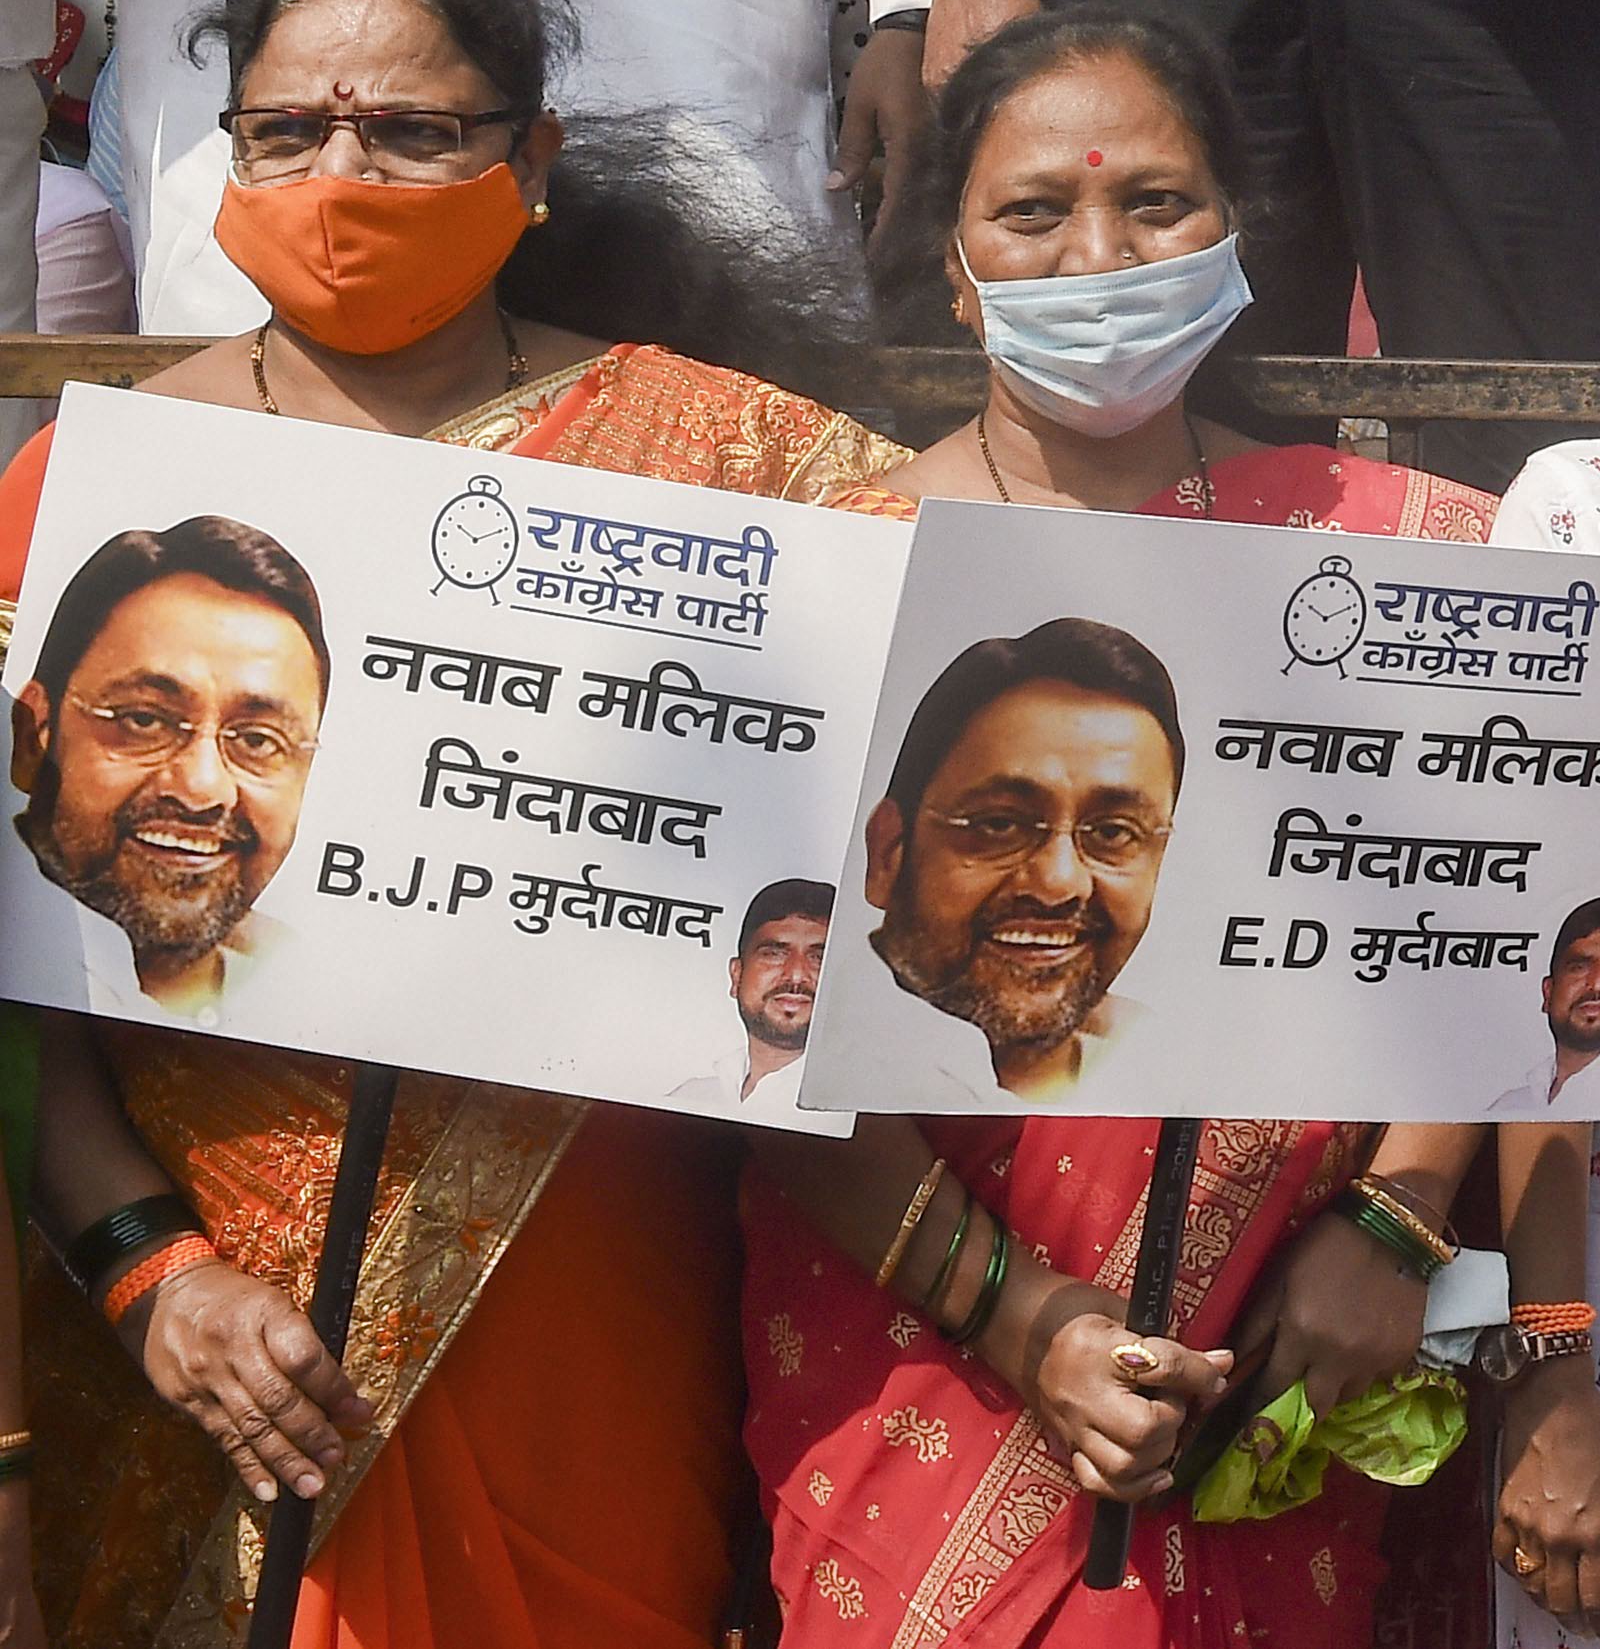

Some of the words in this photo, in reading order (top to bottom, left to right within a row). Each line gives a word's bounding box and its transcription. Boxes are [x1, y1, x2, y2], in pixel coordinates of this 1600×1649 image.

[676, 593, 768, 636] पार्टी
[363, 636, 562, 714] नवाब
[579, 661, 825, 752] मलिक
[1508, 642, 1589, 683] पार्टी
[1215, 719, 1403, 777] नवाब
[420, 738, 722, 858] जिंदाबाद
[1268, 808, 1542, 892] जिंदाबाद
[317, 842, 492, 914] B.J.P
[510, 864, 723, 947] मुर्दाबाद
[1220, 917, 1328, 968] E.D
[1351, 911, 1539, 982] मुर्दाबाद
